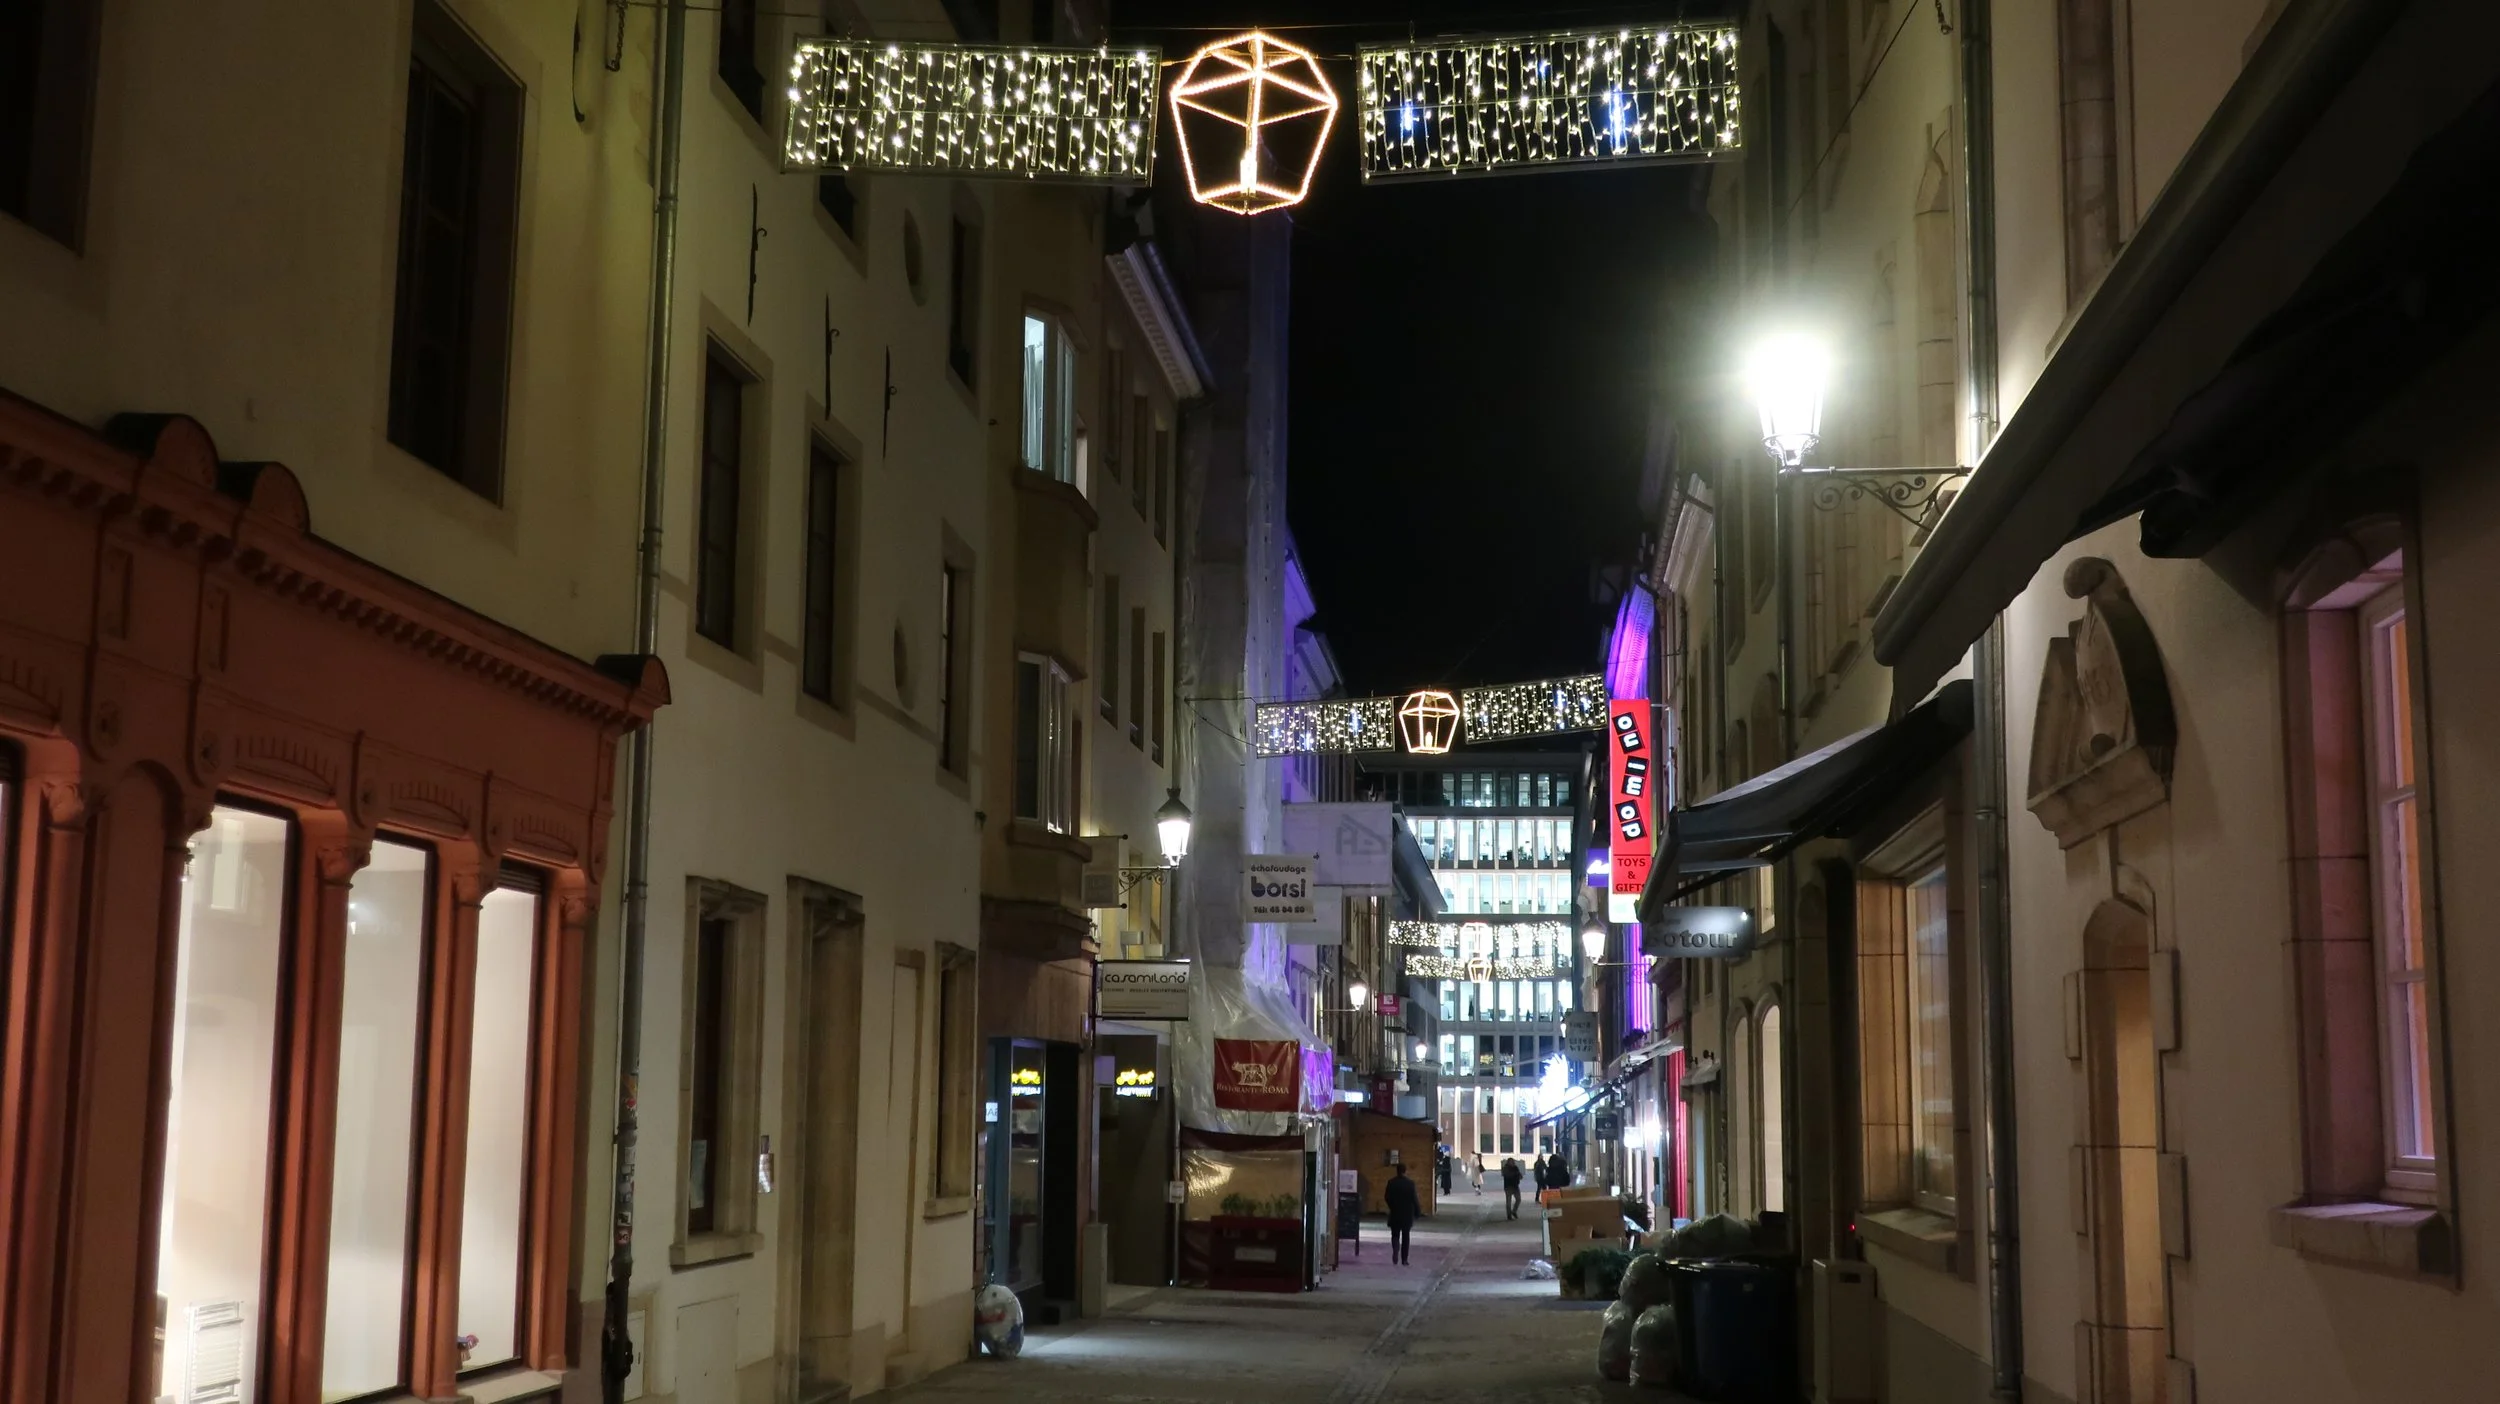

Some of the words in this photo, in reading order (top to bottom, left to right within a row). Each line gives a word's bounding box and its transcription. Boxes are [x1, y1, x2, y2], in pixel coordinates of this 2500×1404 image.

[1617, 858, 1646, 867] TOYS
[1250, 864, 1306, 875] échafaudage
[1627, 870, 1636, 880] &
[1250, 875, 1306, 898] borsi
[1615, 883, 1645, 892] GIFT
[1104, 971, 1187, 984] casamilano
[1262, 1084, 1290, 1095] ROMA
